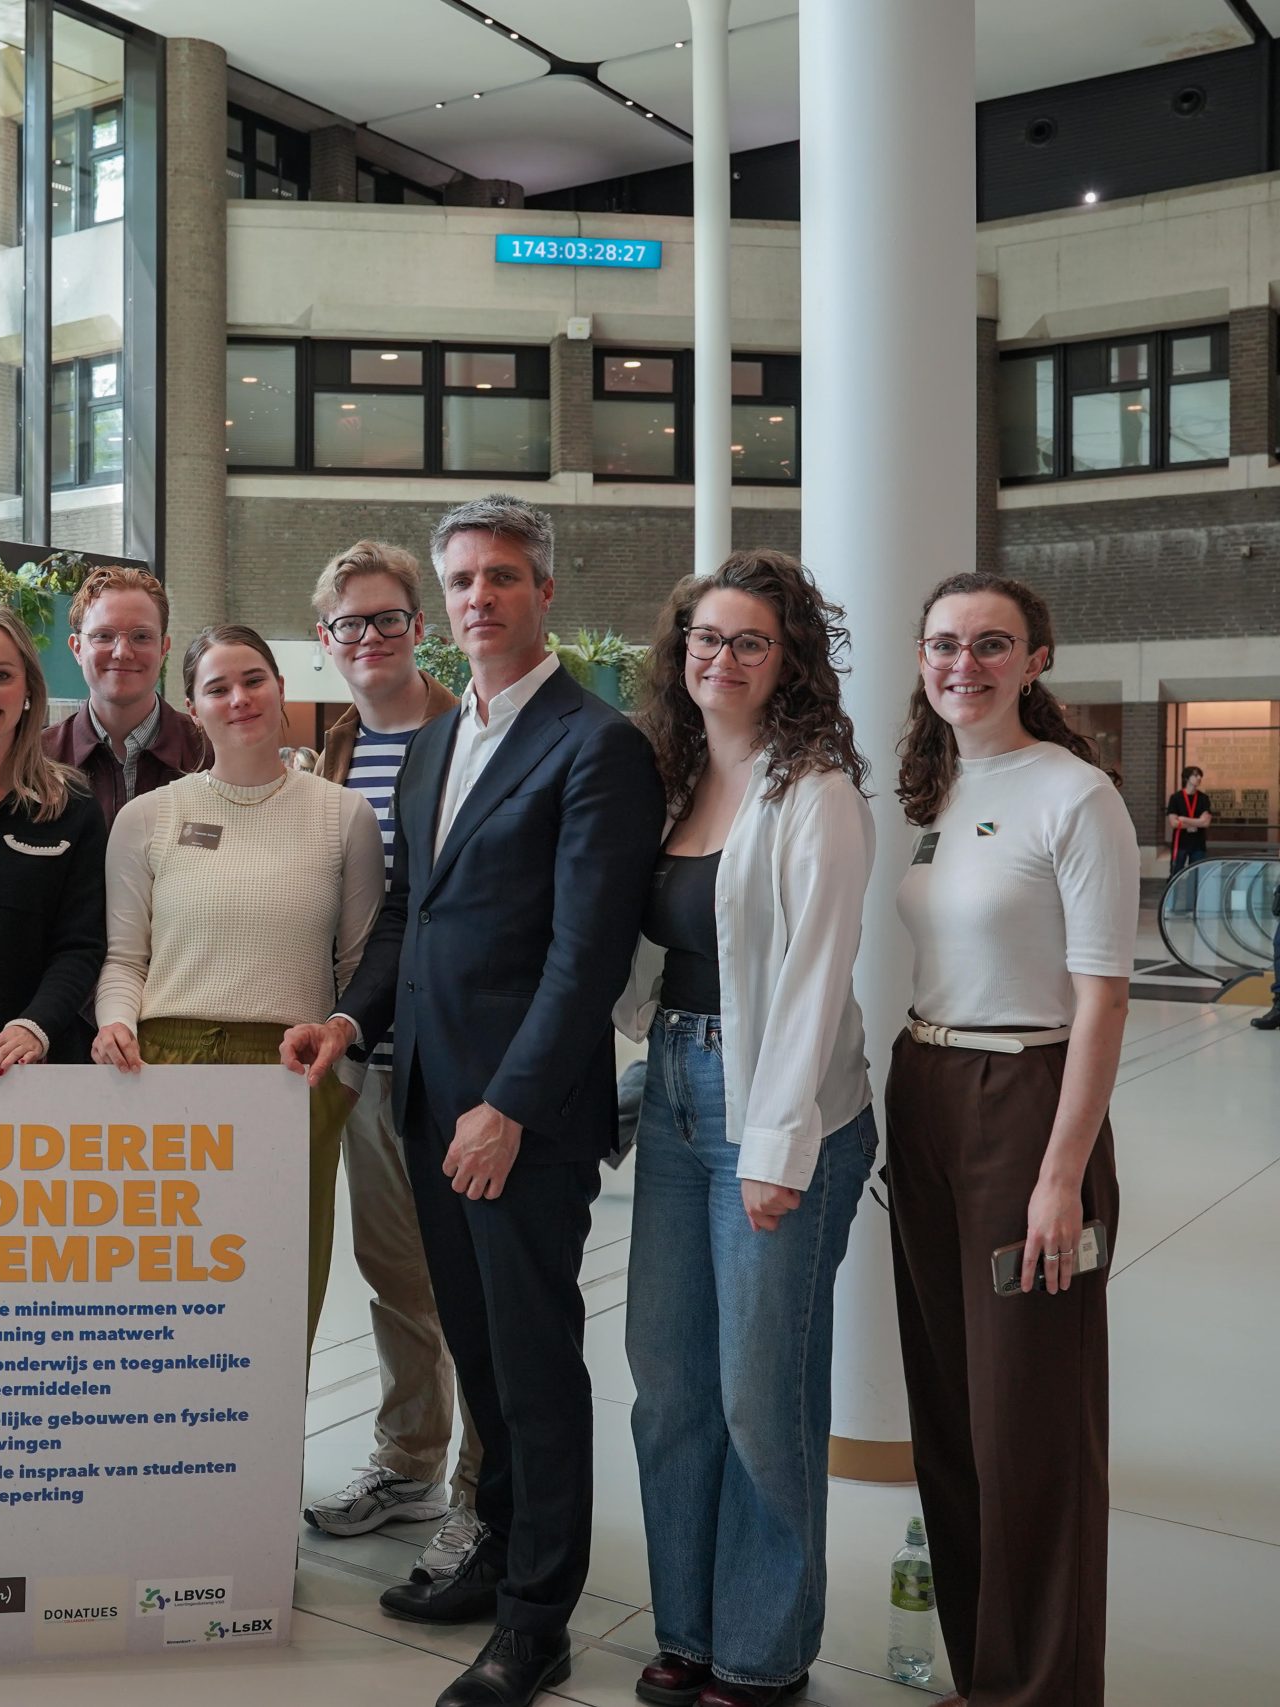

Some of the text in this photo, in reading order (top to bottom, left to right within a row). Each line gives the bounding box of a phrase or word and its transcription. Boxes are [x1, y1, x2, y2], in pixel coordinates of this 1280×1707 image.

[512, 240, 646, 262] 1743:03:28:27
[15, 1301, 177, 1316] minimumnormen
[182, 1303, 226, 1315] voor
[51, 1330, 74, 1341] en
[79, 1326, 175, 1341] maatwerk
[92, 1358, 116, 1371] en
[120, 1353, 251, 1373] toegankelijke
[47, 1411, 148, 1429] gebouwen
[153, 1412, 176, 1424] en
[180, 1408, 249, 1427] fysieke
[19, 1463, 100, 1482] inspraak
[104, 1465, 138, 1476] van
[142, 1461, 237, 1475] studenten
[174, 1588, 226, 1602] LBVSO
[44, 1606, 118, 1620] DONATUES
[232, 1619, 273, 1633] LsBX
